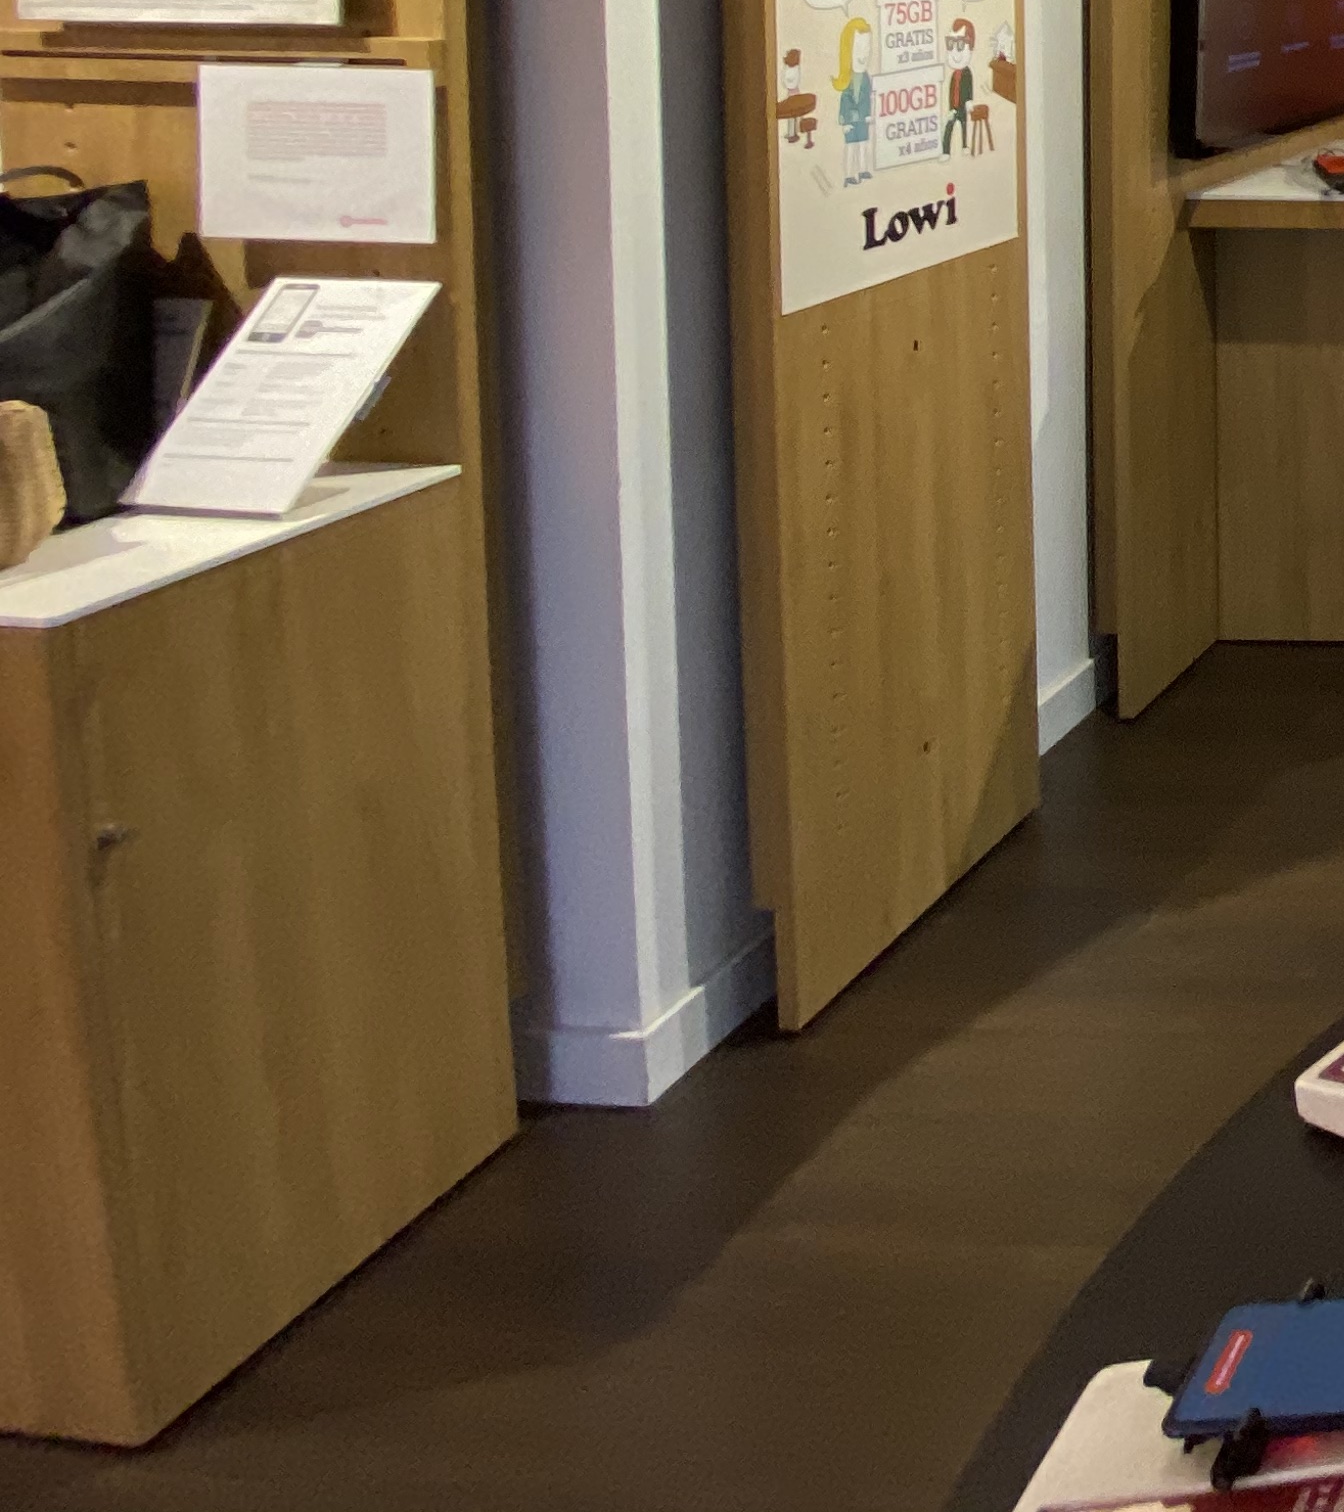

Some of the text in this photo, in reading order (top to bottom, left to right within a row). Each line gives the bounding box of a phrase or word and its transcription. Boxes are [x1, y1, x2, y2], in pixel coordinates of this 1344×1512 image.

[885, 0, 934, 26] 75GB
[885, 29, 934, 49] GRATIS
[879, 83, 937, 117] 100GB
[885, 114, 938, 140] GRATIS
[863, 182, 958, 251] Lowi
